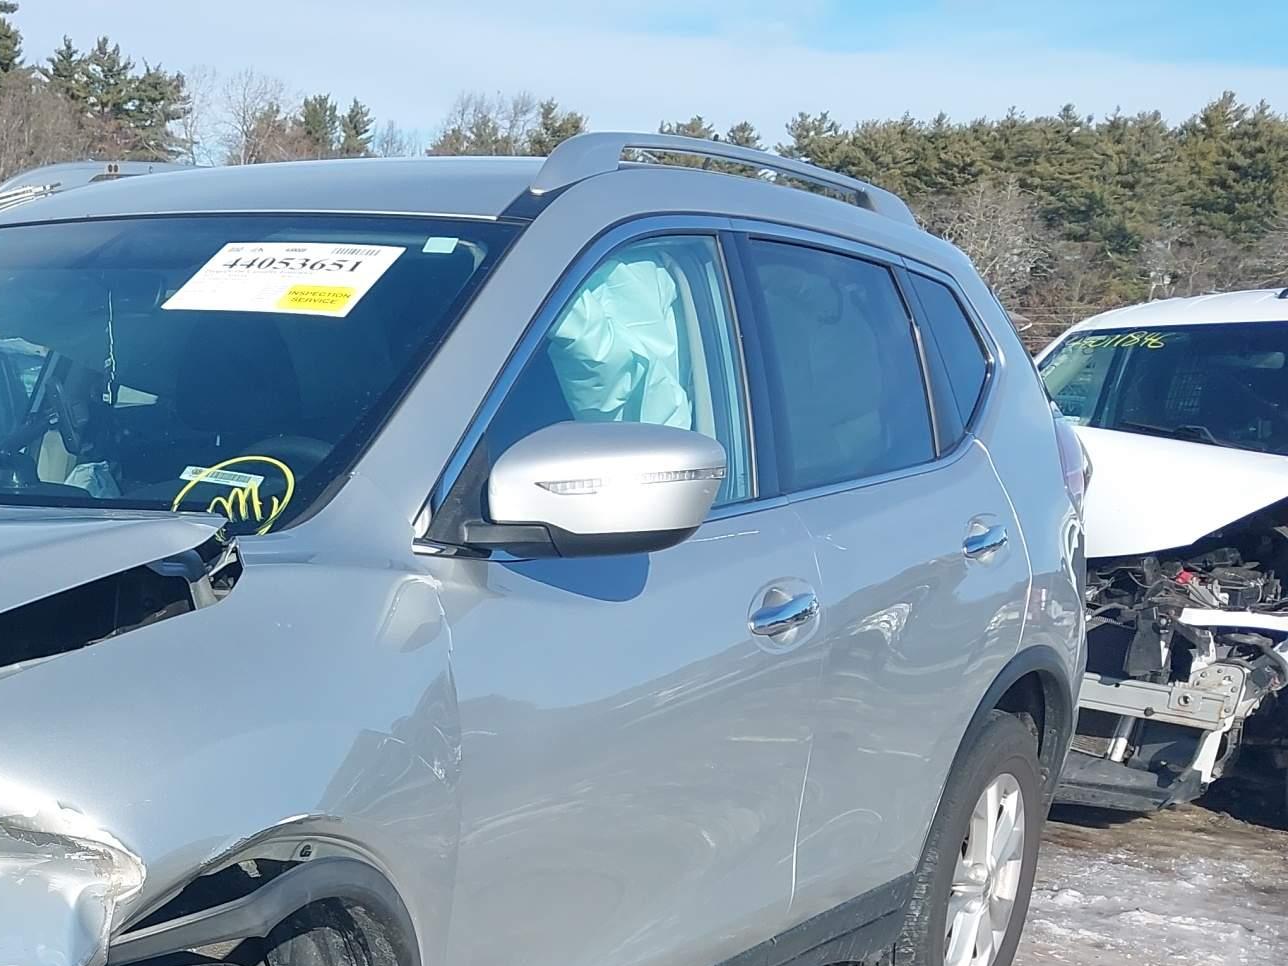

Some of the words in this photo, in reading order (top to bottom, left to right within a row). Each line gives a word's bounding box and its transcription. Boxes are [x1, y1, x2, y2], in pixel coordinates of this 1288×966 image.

[222, 256, 363, 273] 44053651
[288, 290, 352, 299] INSPECTION
[290, 297, 338, 305] SERVICE
